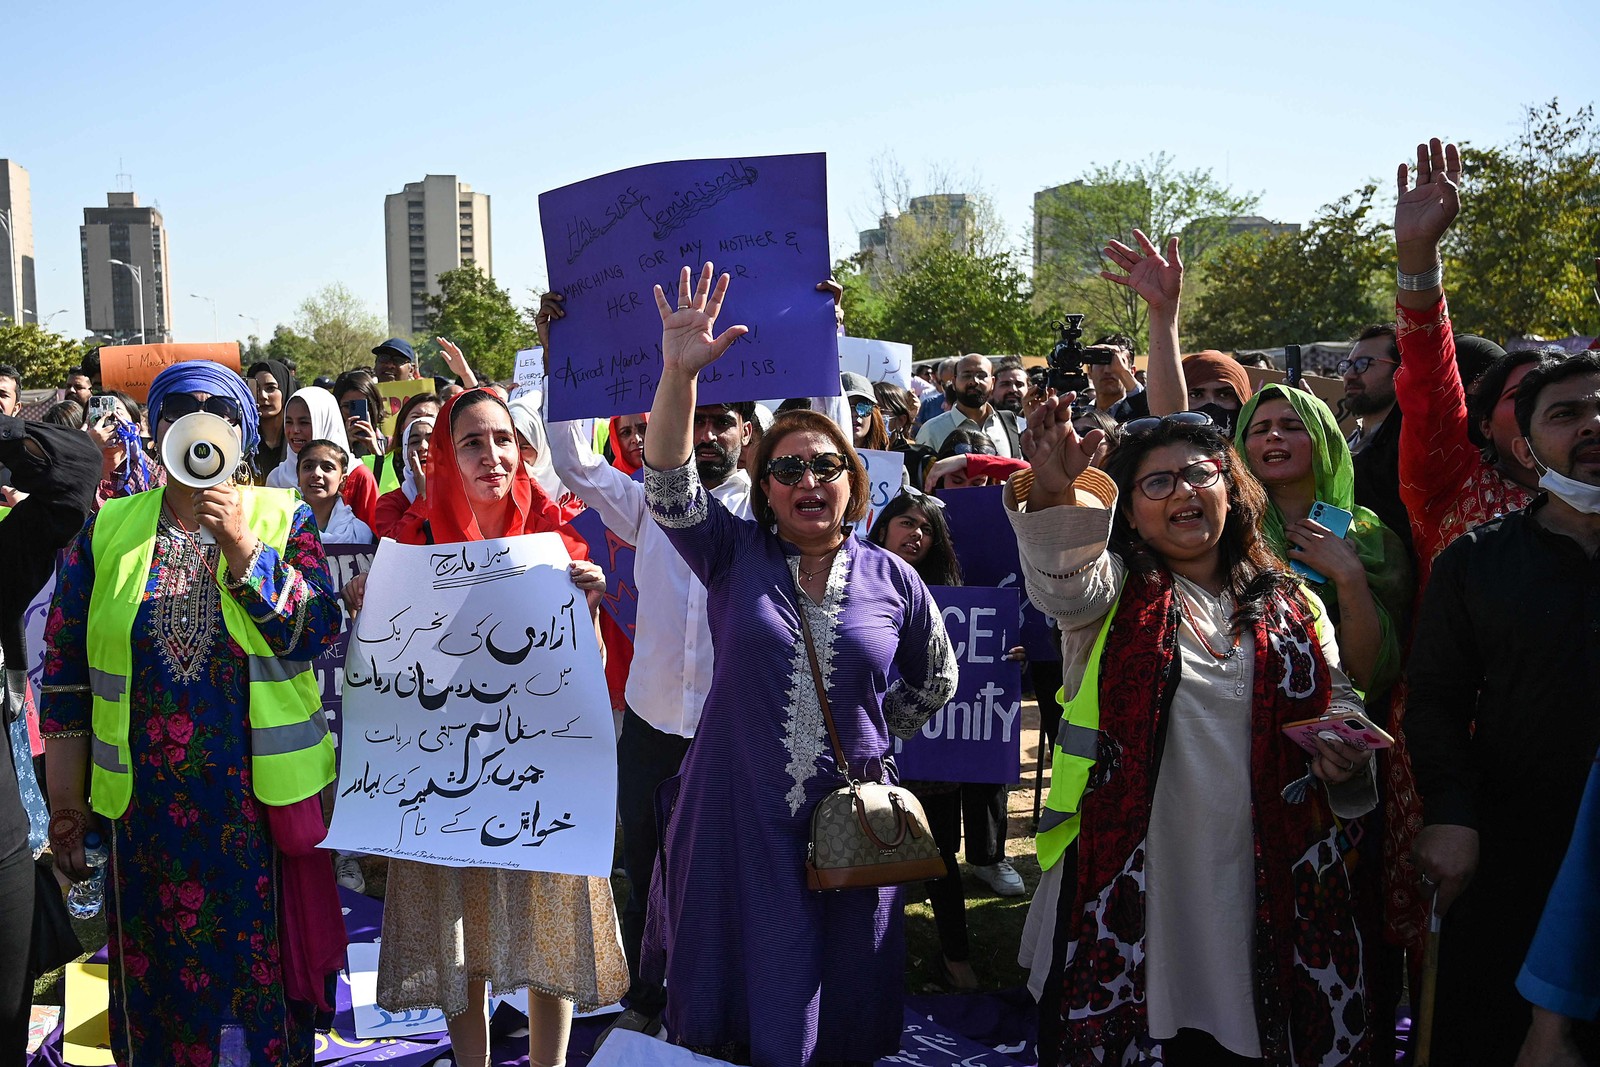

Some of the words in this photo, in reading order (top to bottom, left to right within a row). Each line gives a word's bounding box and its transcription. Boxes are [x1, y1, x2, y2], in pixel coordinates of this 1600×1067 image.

[563, 265, 624, 302] MARCHING
[639, 250, 669, 273] FOR
[680, 240, 702, 266] MY
[719, 231, 778, 252] MOTHER
[607, 292, 643, 319] HER
[611, 347, 650, 376] March
[430, 546, 475, 576] مارچ
[438, 613, 493, 656] کی
[486, 594, 577, 665] آزادی
[346, 655, 391, 694] ریاست
[525, 667, 572, 696] میں
[365, 723, 411, 752] ریاست
[551, 716, 593, 739] کے
[383, 766, 420, 795] کی
[396, 805, 427, 849] نام
[440, 806, 476, 834] کے
[480, 800, 576, 847] خواتین
